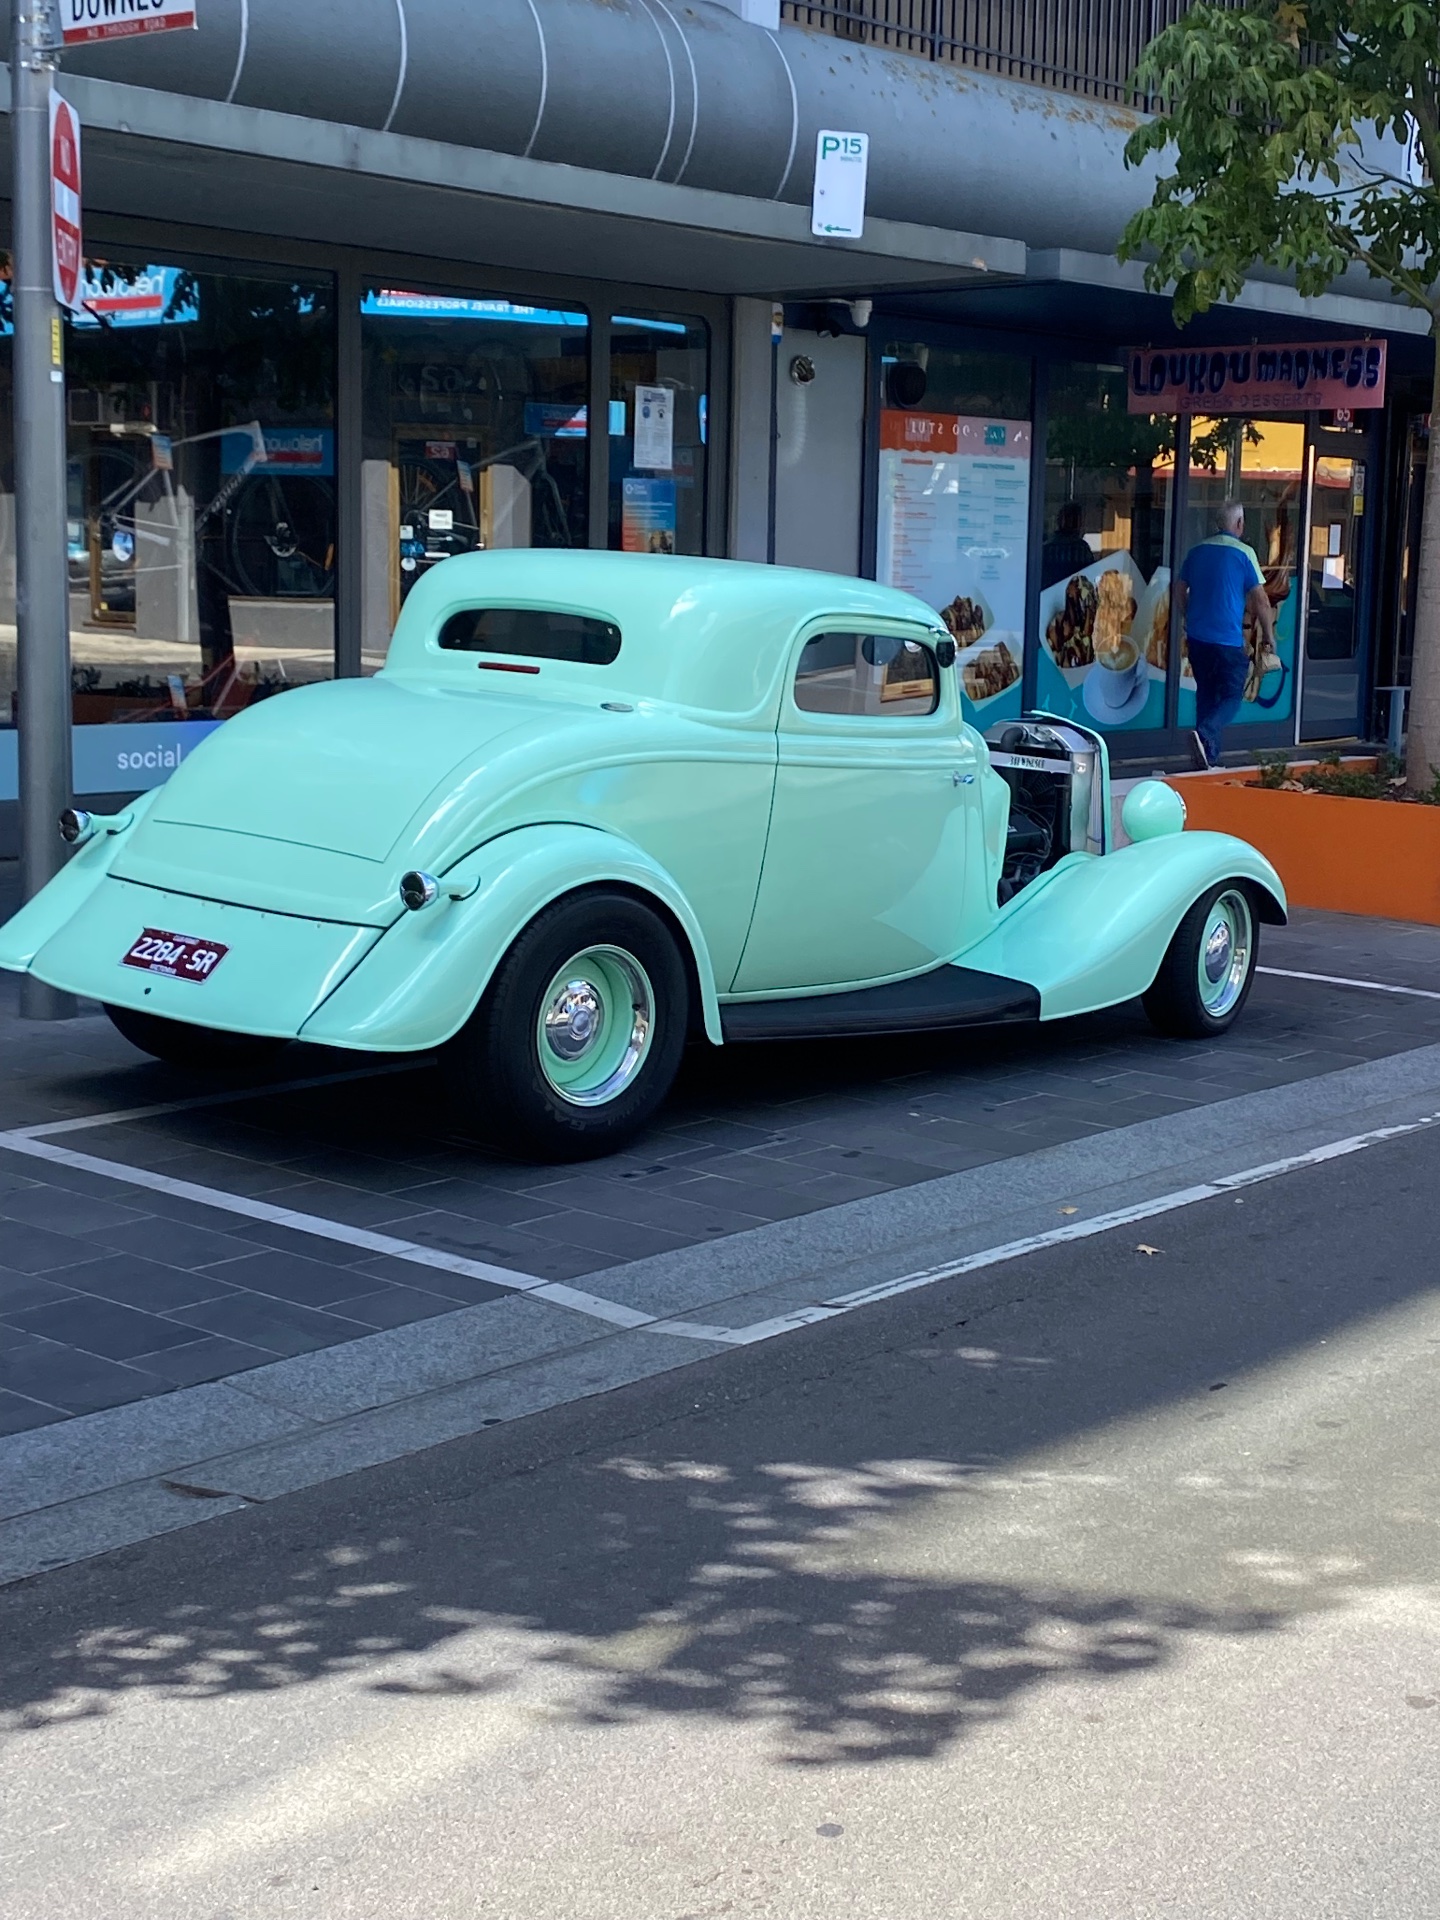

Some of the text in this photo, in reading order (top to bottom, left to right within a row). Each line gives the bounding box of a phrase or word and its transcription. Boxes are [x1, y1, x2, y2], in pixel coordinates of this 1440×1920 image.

[1255, 346, 1382, 390] MADNESS
[1180, 392, 1323, 409] GREEK DESSERTS
[1336, 407, 1351, 422] 65
[117, 743, 181, 769] social
